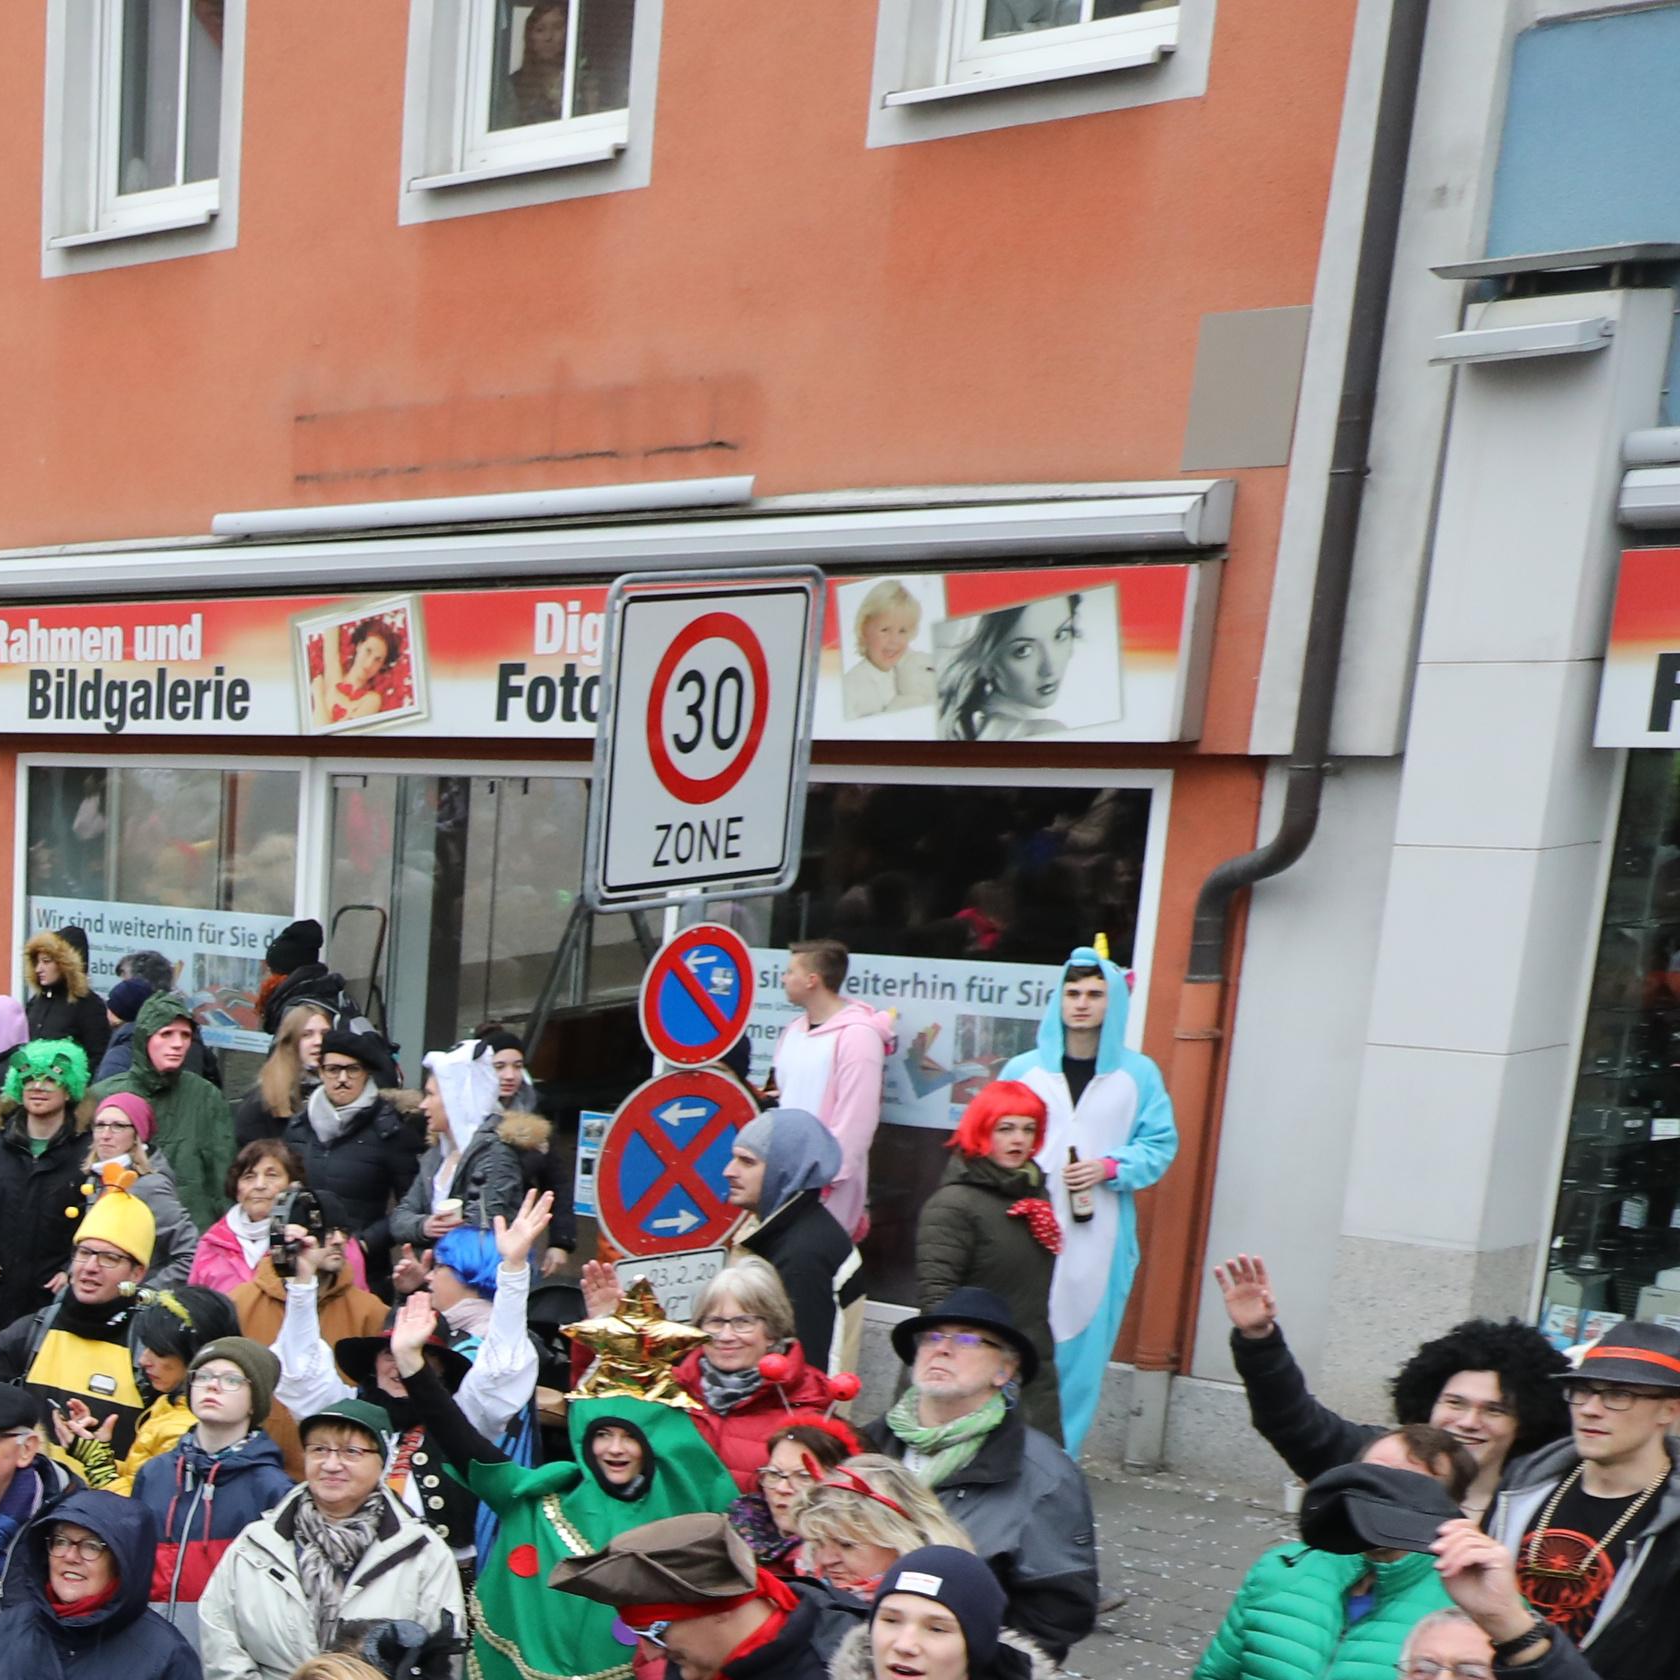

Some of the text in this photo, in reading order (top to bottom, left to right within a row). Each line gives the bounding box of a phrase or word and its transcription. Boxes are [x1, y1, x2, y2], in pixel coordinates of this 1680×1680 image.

[134, 613, 203, 661] und
[28, 666, 252, 733] Bildgalerie
[673, 666, 744, 754] 30
[652, 816, 744, 868] ZONE
[36, 908, 276, 948] Wir sind weiterhin für Sie d
[846, 970, 956, 1001] eiterhin
[966, 974, 1009, 1005] für
